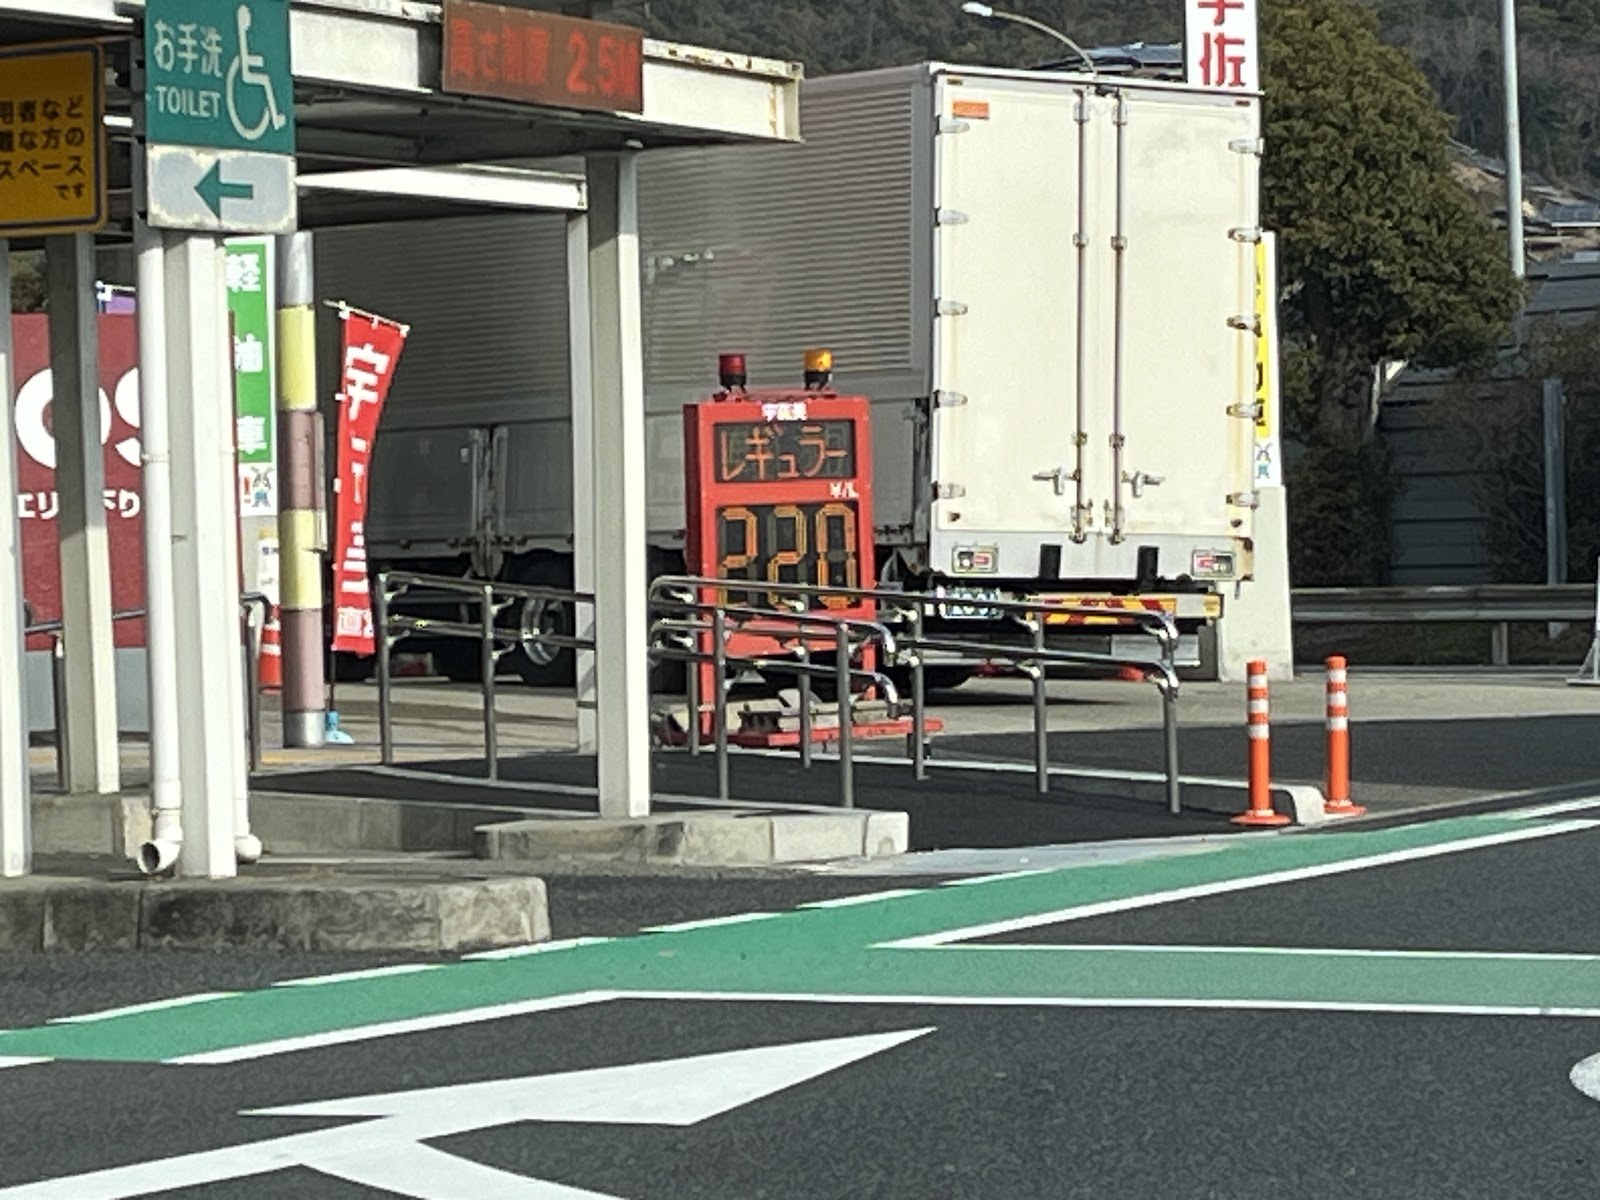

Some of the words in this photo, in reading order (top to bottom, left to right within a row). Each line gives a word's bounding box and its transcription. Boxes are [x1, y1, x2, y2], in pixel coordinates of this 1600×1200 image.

[153, 19, 224, 78] お手洗
[154, 85, 221, 119] TOILET
[55, 181, 86, 200] です
[720, 423, 849, 481] レギュラー
[718, 501, 858, 612] 220
